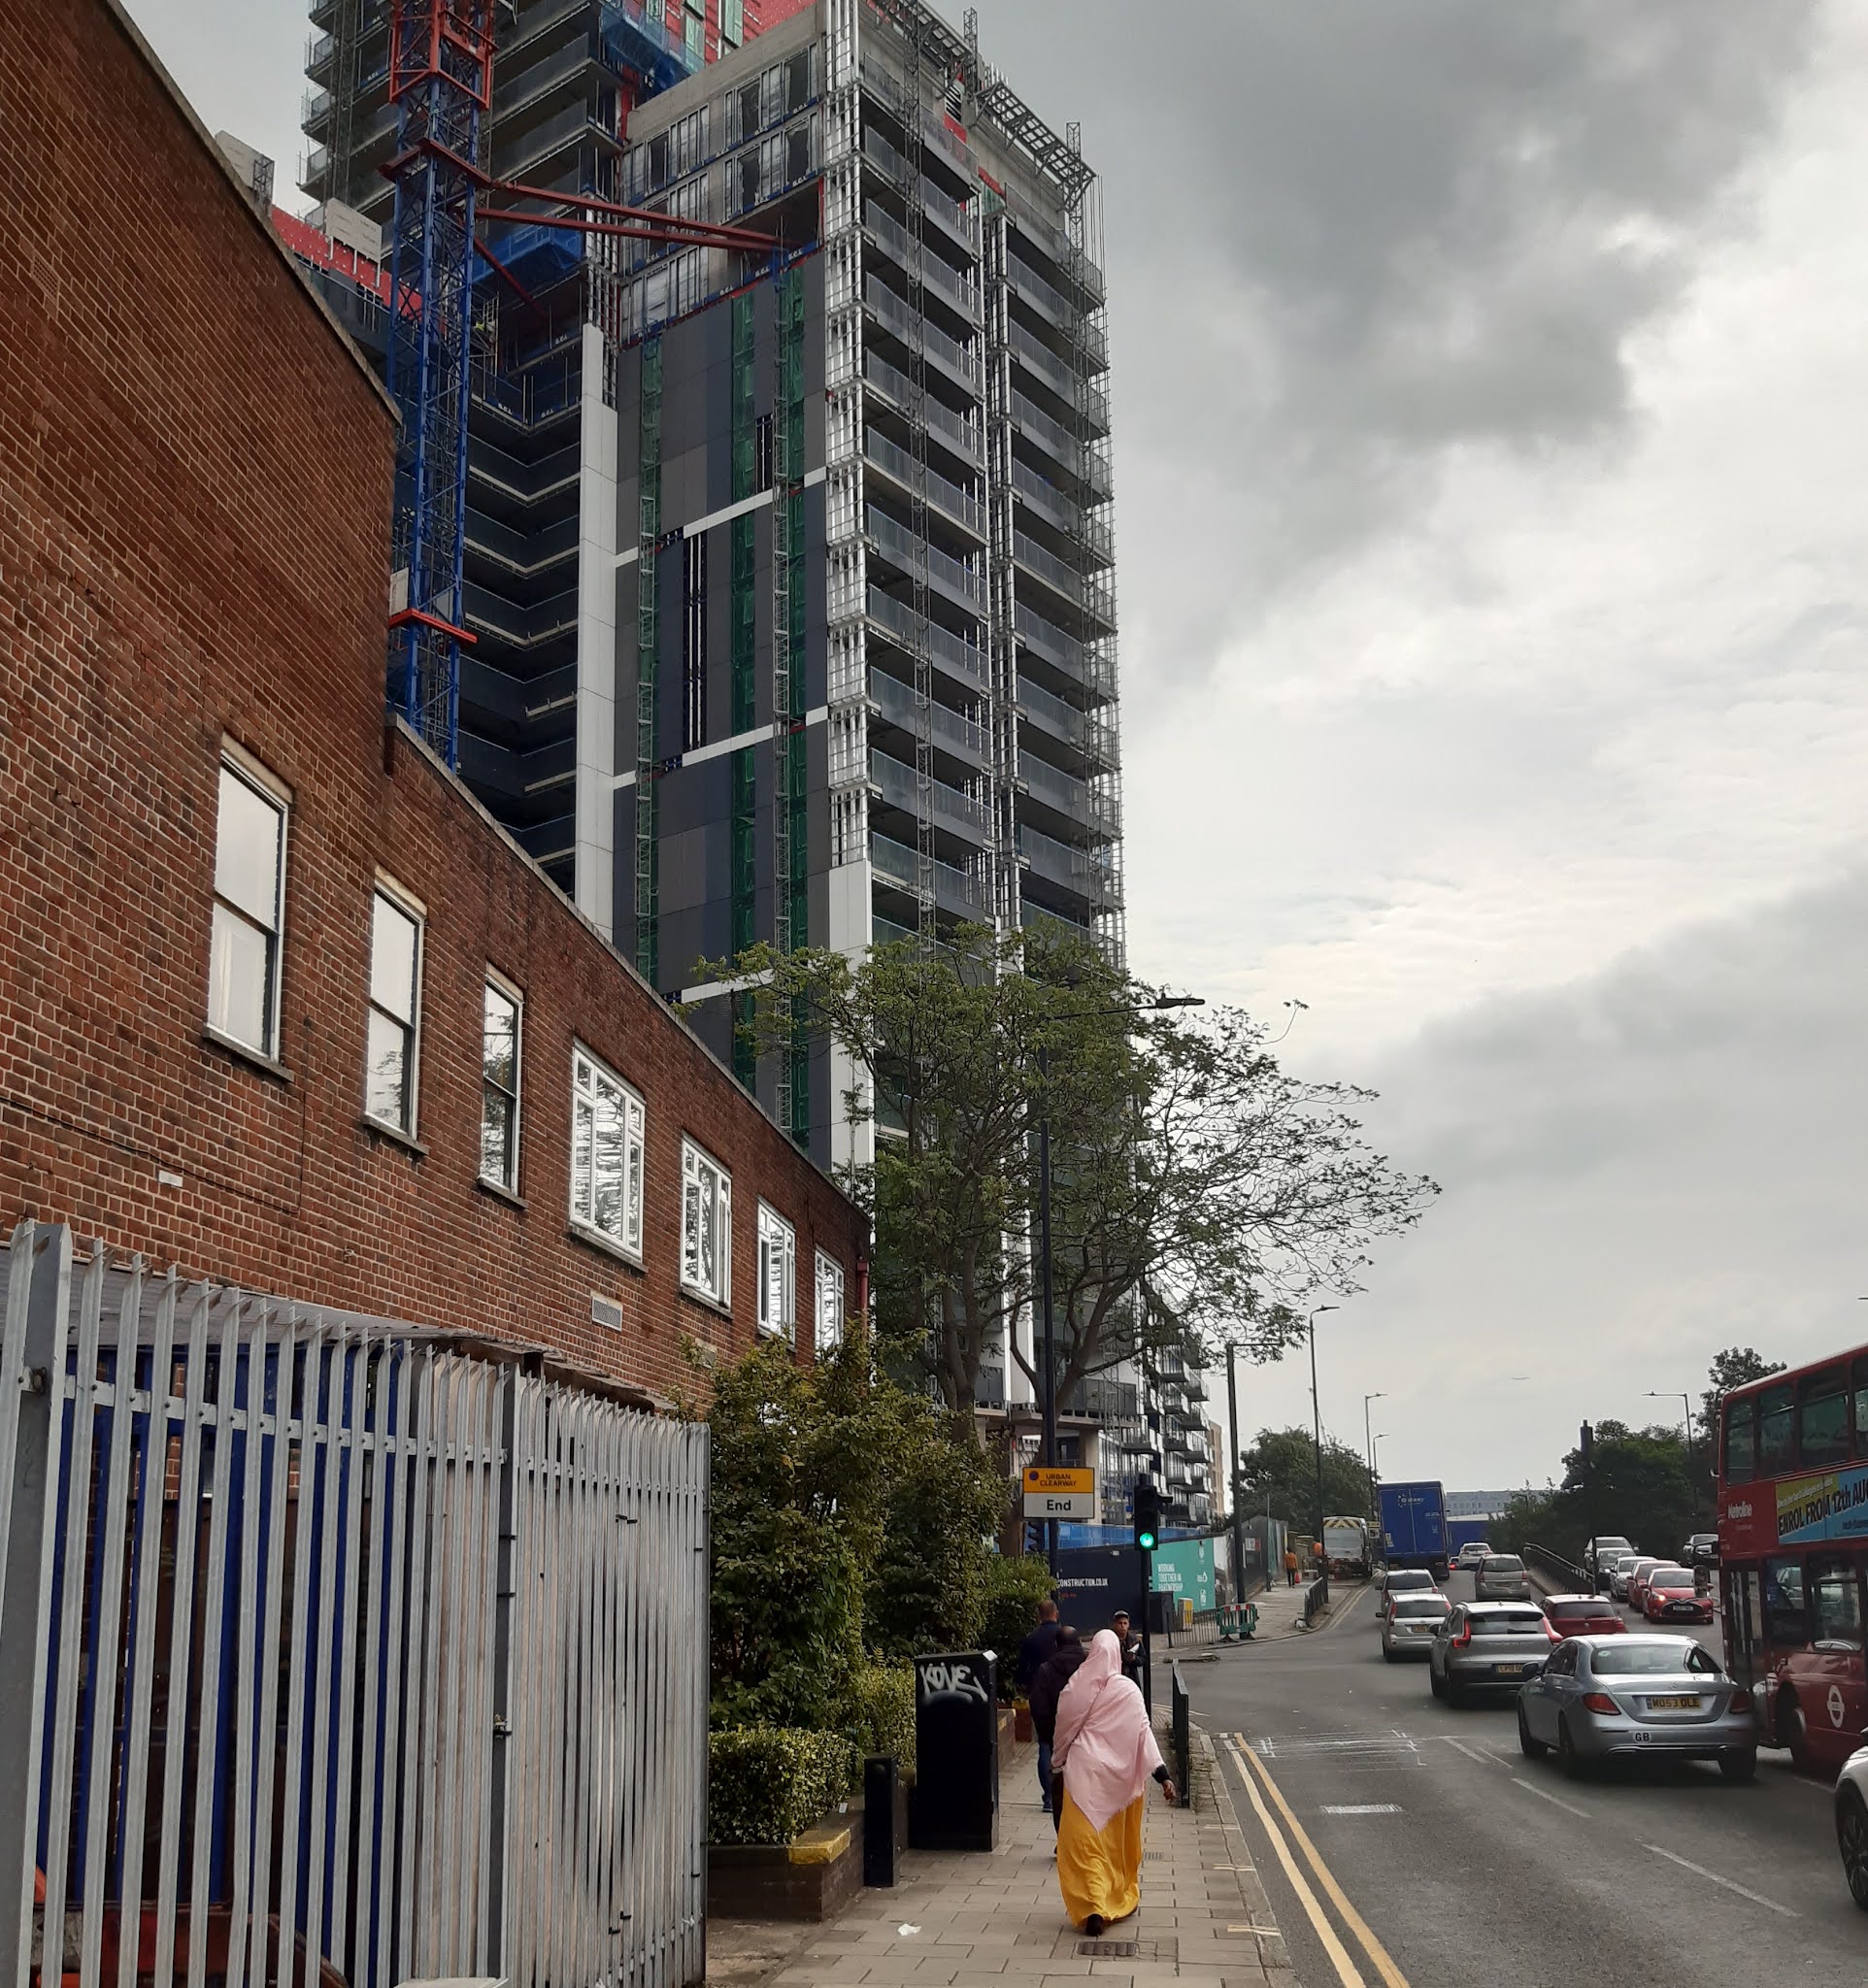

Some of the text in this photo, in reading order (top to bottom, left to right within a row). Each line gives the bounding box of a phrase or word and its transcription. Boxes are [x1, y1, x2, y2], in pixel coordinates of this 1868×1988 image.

[1047, 1499, 1072, 1511] End
[1778, 1507, 1805, 1536] ENROL
[1806, 1494, 1831, 1526] FROM
[1832, 1484, 1851, 1514] 12th
[1852, 1477, 1868, 1506] AU
[1635, 1732, 1650, 1742] GB
